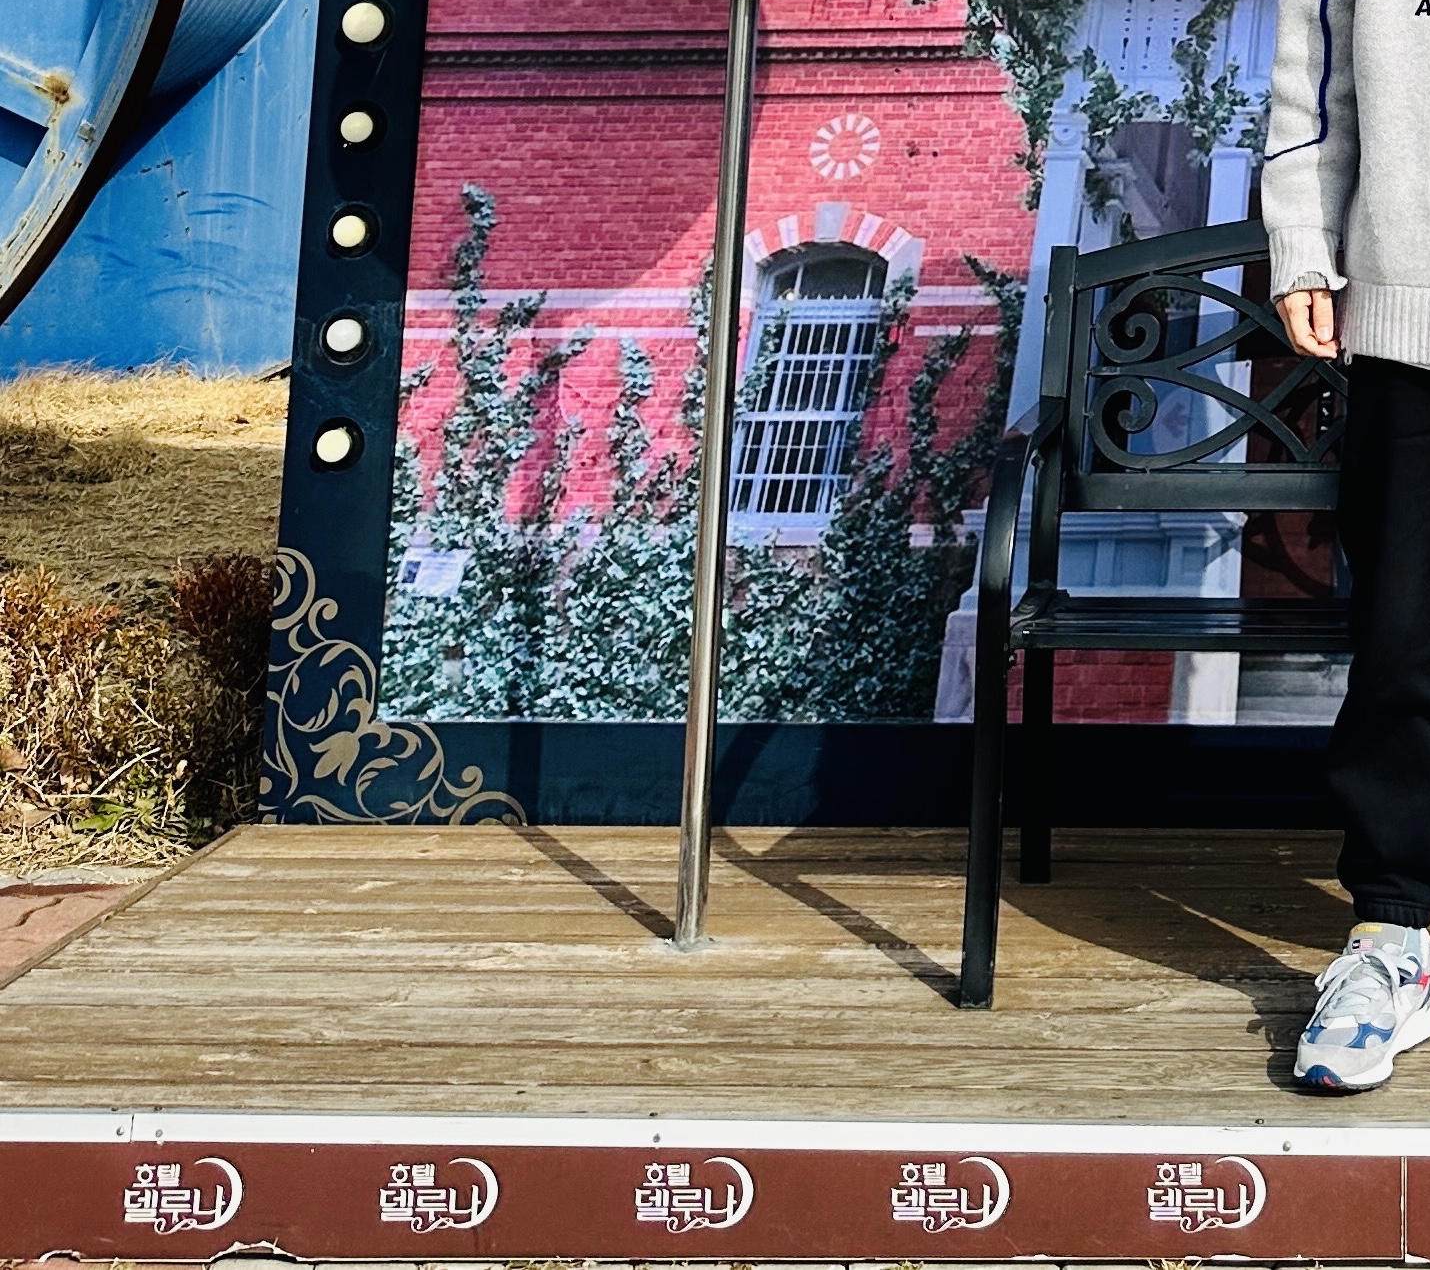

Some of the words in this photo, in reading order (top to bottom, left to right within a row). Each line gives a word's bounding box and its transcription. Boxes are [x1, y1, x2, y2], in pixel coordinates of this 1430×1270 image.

[133, 1164, 181, 1188] 호텔
[388, 1164, 435, 1187] 호텔
[643, 1163, 690, 1187] 호텔
[899, 1163, 946, 1186] 호텔
[1155, 1163, 1203, 1186] 호텔
[123, 1189, 227, 1235] 델루나
[379, 1188, 483, 1234] 델루나
[635, 1188, 739, 1234] 델루나
[890, 1187, 994, 1233] 델루나
[1147, 1187, 1251, 1233] 델루나
